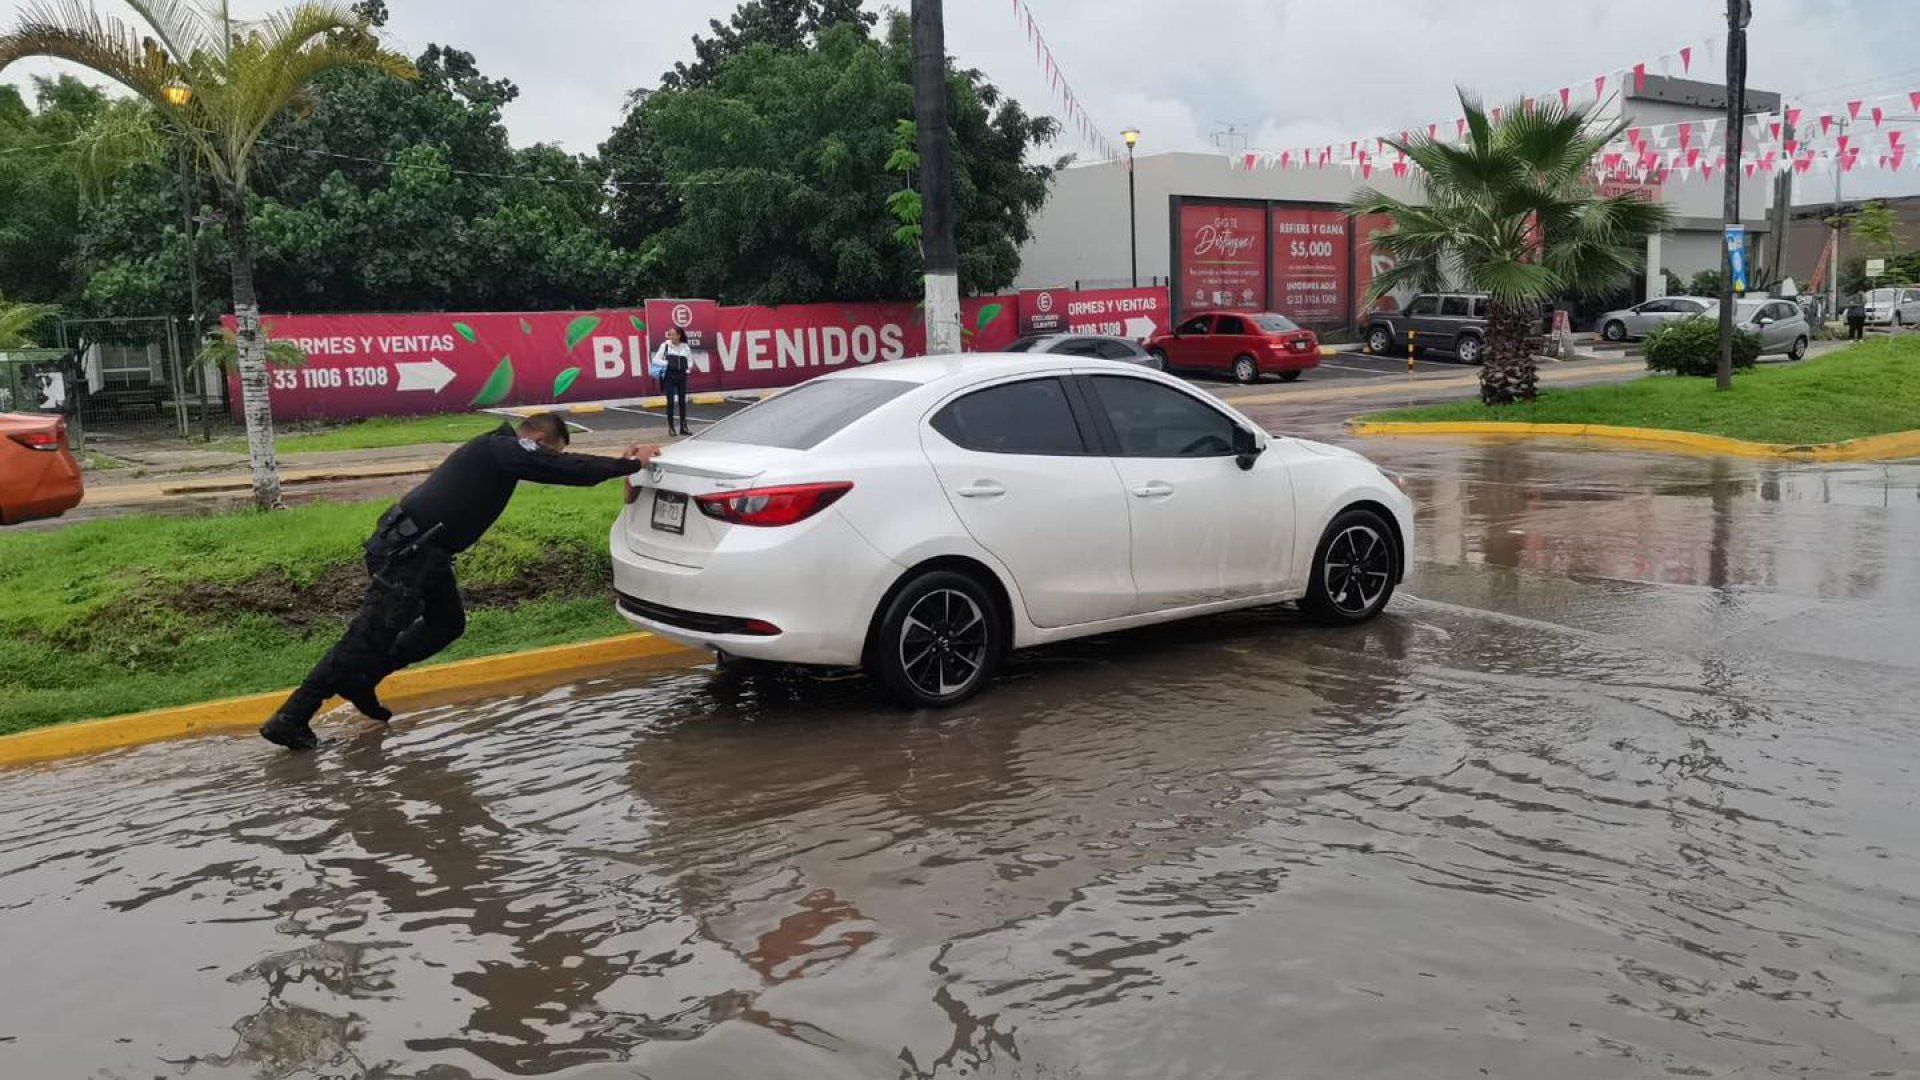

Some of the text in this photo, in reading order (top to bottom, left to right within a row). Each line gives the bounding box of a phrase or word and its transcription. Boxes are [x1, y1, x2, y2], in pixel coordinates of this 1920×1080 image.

[1311, 223, 1318, 234] Y
[1319, 223, 1345, 236] GANA
[1290, 238, 1332, 259] $5,000
[1067, 297, 1157, 316] ORMES Y VENTAS
[359, 336, 374, 354] Y
[377, 334, 455, 354] VENTAS
[273, 366, 388, 389] 33 1106 1308
